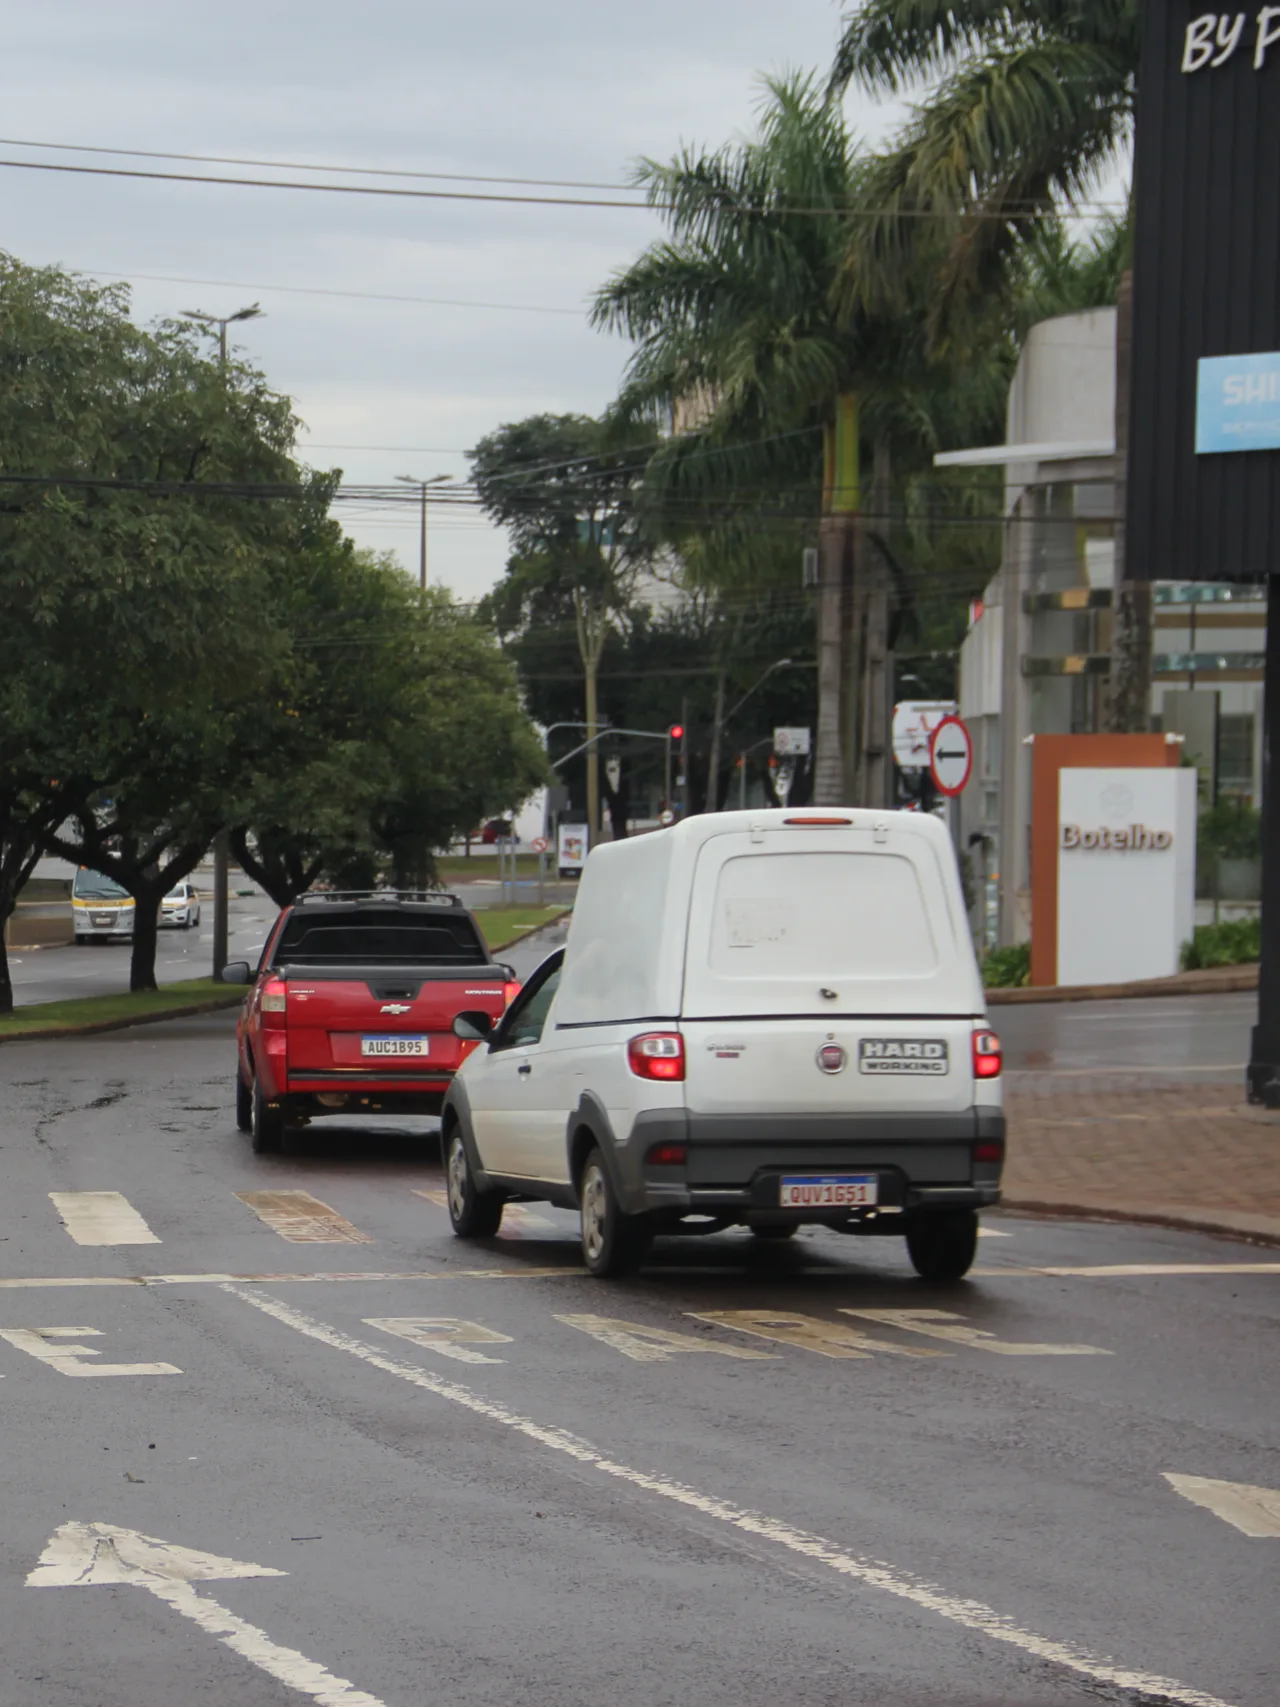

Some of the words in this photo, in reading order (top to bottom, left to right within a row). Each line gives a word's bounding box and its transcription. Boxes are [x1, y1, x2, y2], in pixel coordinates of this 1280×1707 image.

[1181, 13, 1246, 73] BY
[1060, 823, 1173, 851] Botelho
[367, 1041, 422, 1054] AUC1B95
[863, 1043, 943, 1058] HARD
[865, 1061, 943, 1071] WORKING
[360, 1308, 1116, 1364] PARE
